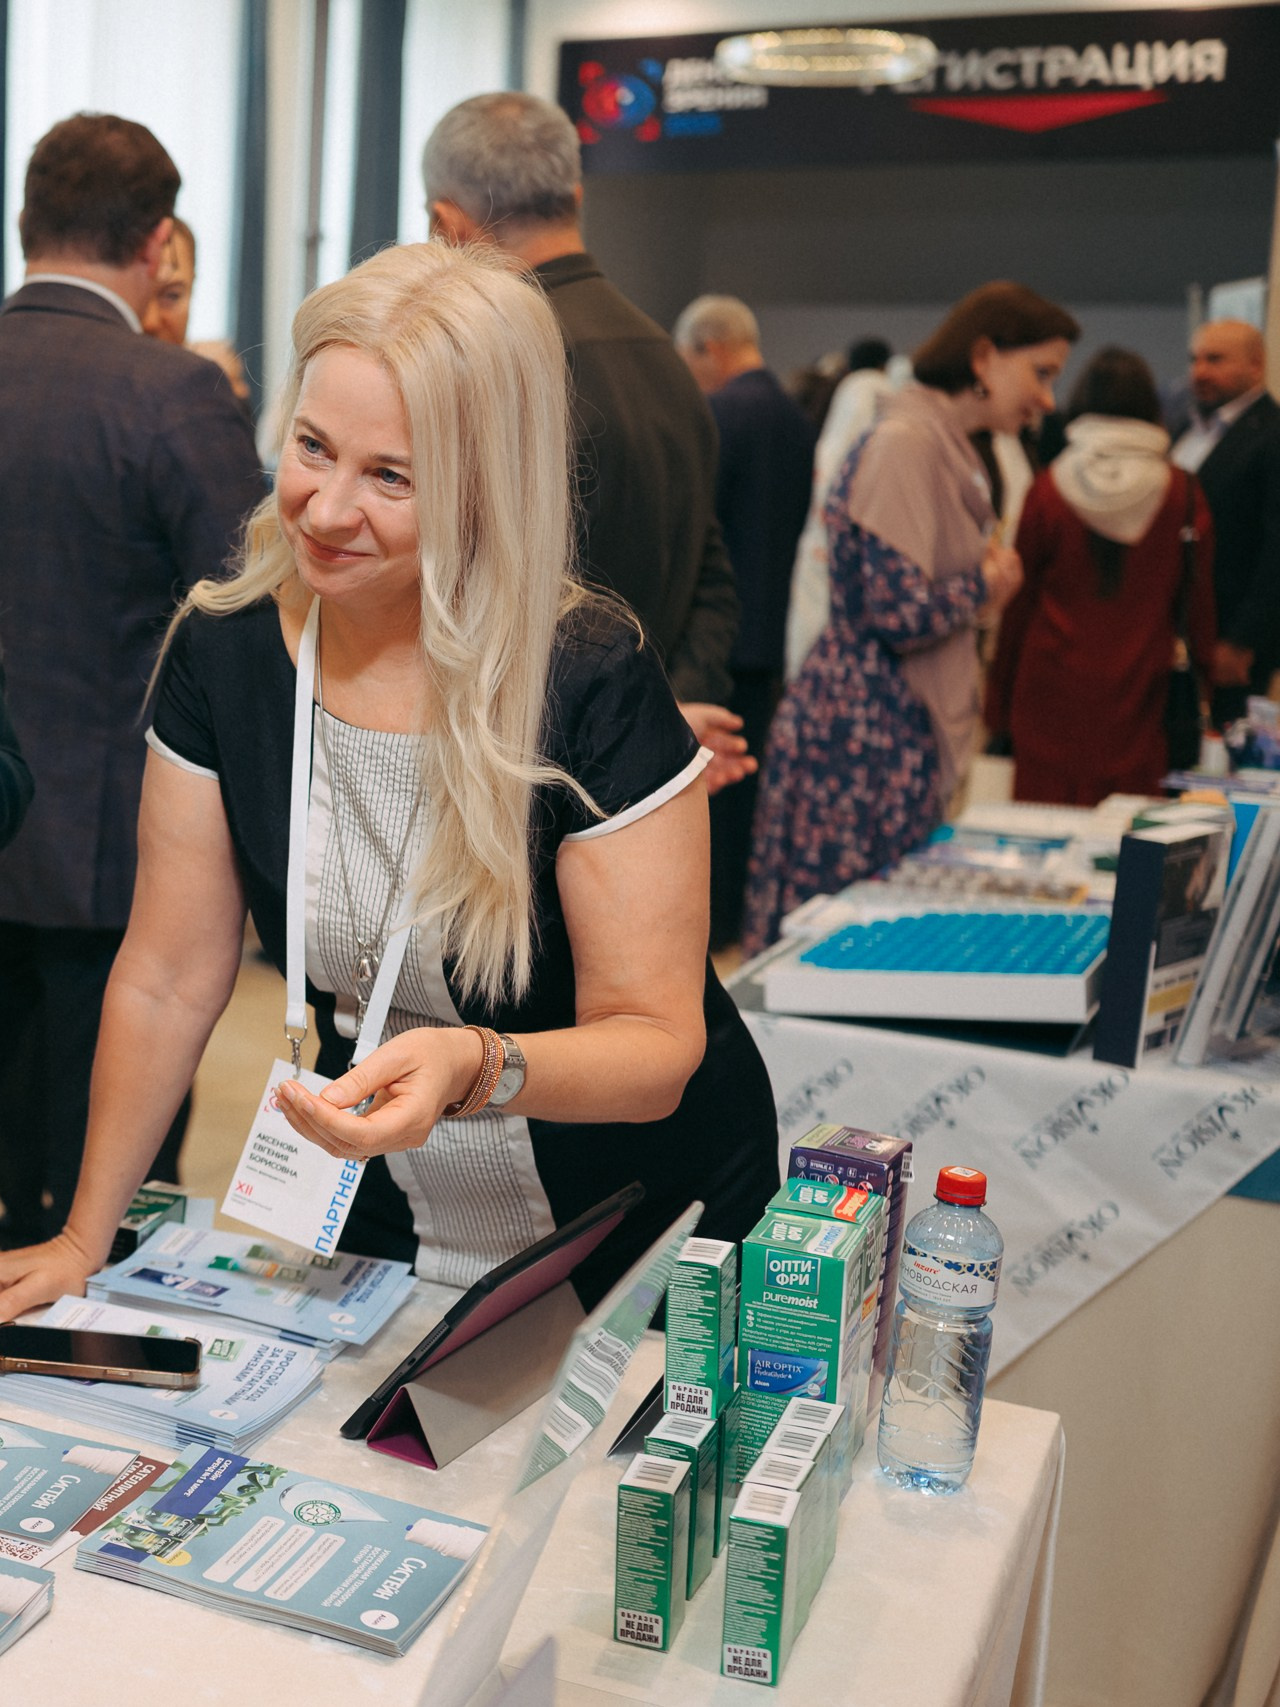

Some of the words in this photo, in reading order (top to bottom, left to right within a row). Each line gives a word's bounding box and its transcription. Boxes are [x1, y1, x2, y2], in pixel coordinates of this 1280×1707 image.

[858, 39, 1227, 95] ГИСТРАЦИЯ
[253, 1142, 289, 1162] ЕВГЕНИЯ
[257, 1132, 298, 1154] АКСЕНОВА
[249, 1153, 297, 1178] БОРИСОВНА
[769, 1260, 815, 1273] ОПТИ-
[776, 1273, 810, 1285] ФРИ
[901, 1262, 978, 1293] НОВОДСКАЯ
[763, 1291, 819, 1309] puremoist
[270, 1347, 283, 1358] ЗА
[233, 1344, 270, 1382] ЛИНЗАМИ
[265, 1350, 297, 1386] ПРОСТОЙ
[755, 1359, 771, 1369] AIR
[773, 1362, 803, 1374] OPTIX
[222, 1359, 275, 1406] КОНТАКТНЫМИ
[672, 1384, 709, 1396] ОБРАЗЕЦ
[676, 1392, 685, 1402] НЕ
[686, 1394, 703, 1405] ДЛЯ
[671, 1402, 708, 1415] ПРОДАЖИ
[204, 1456, 225, 1471] БРЕНД
[205, 1459, 236, 1481] СИСТЕЙН
[93, 1464, 156, 1512] САТЕЛЛИТНЫЙ
[626, 1620, 635, 1629] НЕ
[637, 1622, 654, 1633] ДЛЯ
[620, 1629, 659, 1644] ПРОДАЖИ
